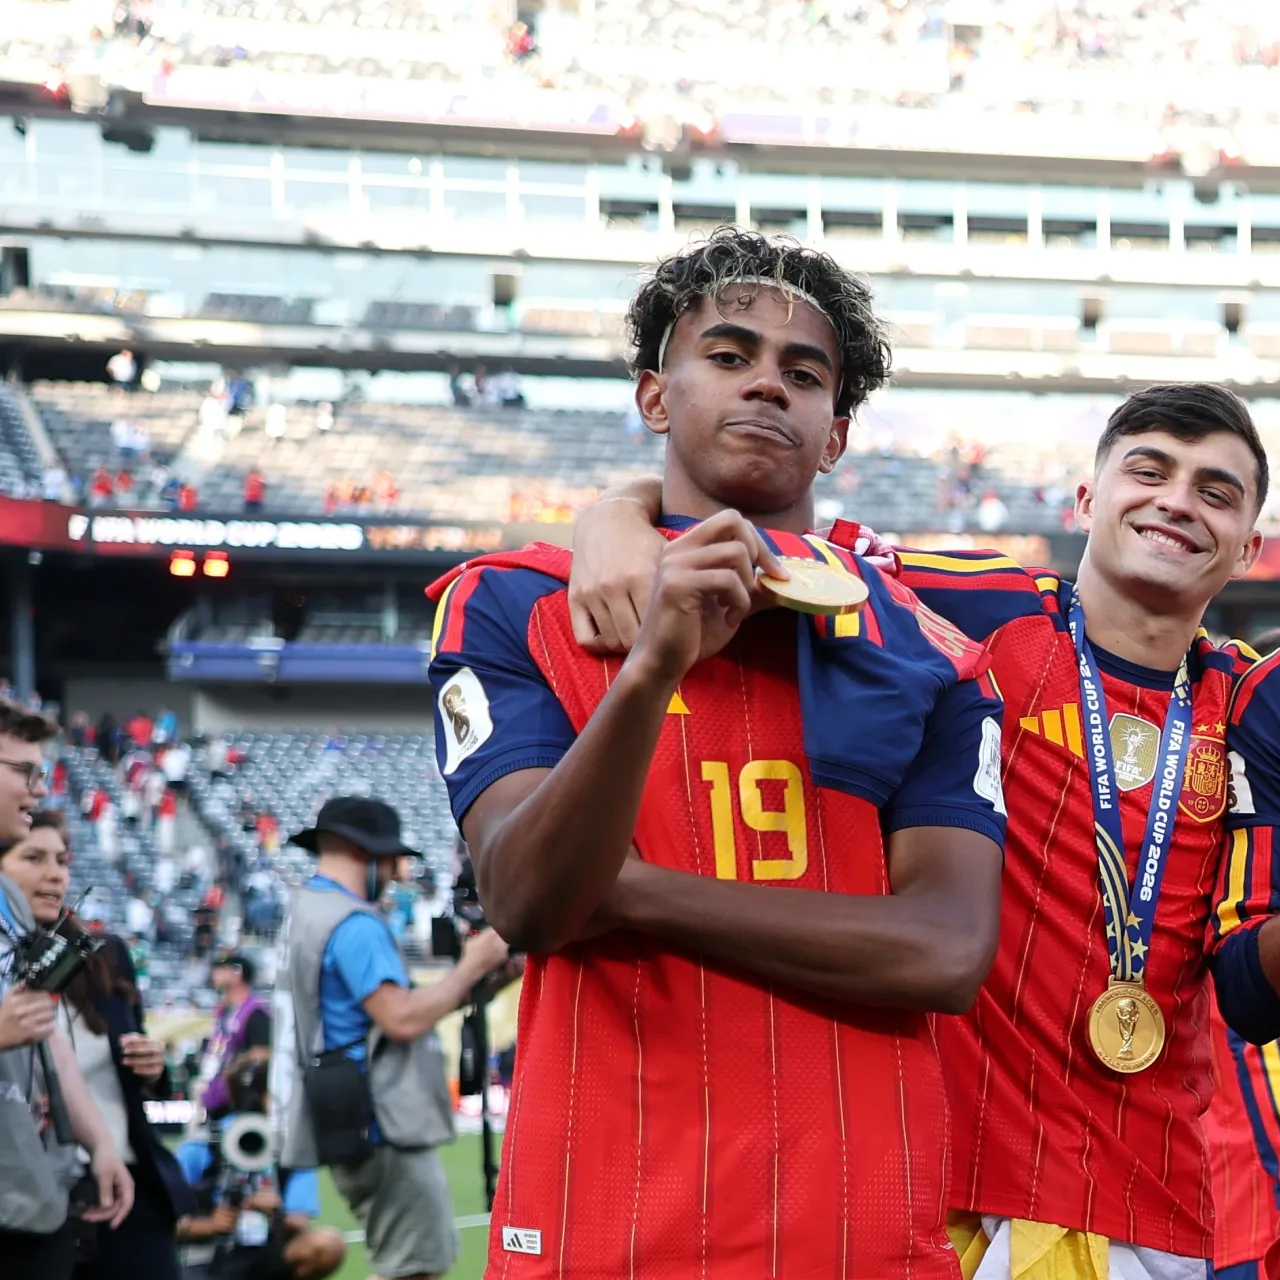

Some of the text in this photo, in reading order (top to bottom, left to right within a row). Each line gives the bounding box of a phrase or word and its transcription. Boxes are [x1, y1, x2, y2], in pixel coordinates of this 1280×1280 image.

[1084, 679, 1099, 710] CUP
[1090, 713, 1107, 772] WORLD
[701, 760, 808, 880] 19
[1097, 774, 1112, 810] FIFA
[1140, 719, 1185, 902] FIFA WORLD CUP 2026
